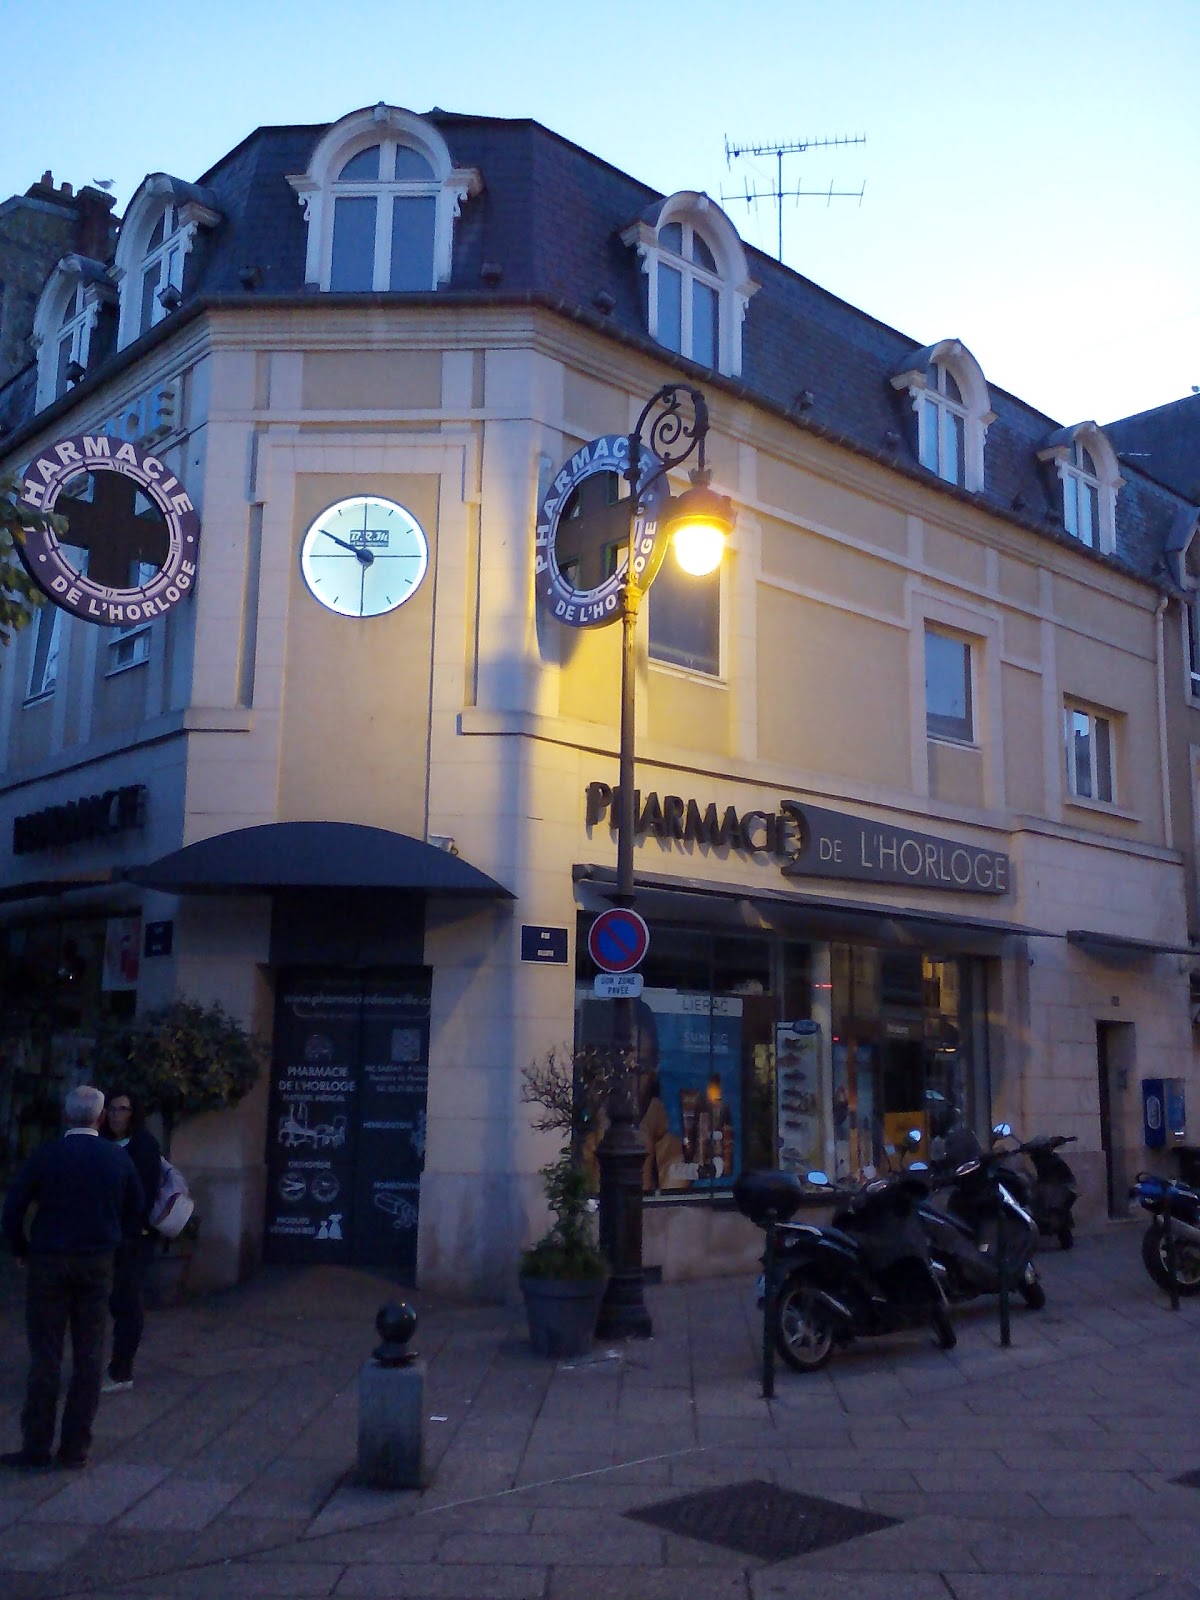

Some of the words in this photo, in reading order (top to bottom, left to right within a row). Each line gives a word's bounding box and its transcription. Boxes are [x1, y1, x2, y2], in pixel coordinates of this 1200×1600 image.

[21, 436, 194, 528] HARMACIE
[536, 436, 652, 575] PHARMACE
[50, 575, 84, 606] DE
[88, 559, 196, 621] L'HORLOGE
[554, 599, 576, 621] DE
[580, 520, 658, 622] L'HOOGE
[585, 781, 801, 863] PHARMACIE
[819, 836, 843, 863] DE
[860, 830, 1007, 891] L'HORLOGE
[682, 998, 729, 1013] LIERAC
[286, 1066, 349, 1078] PHARMACIE
